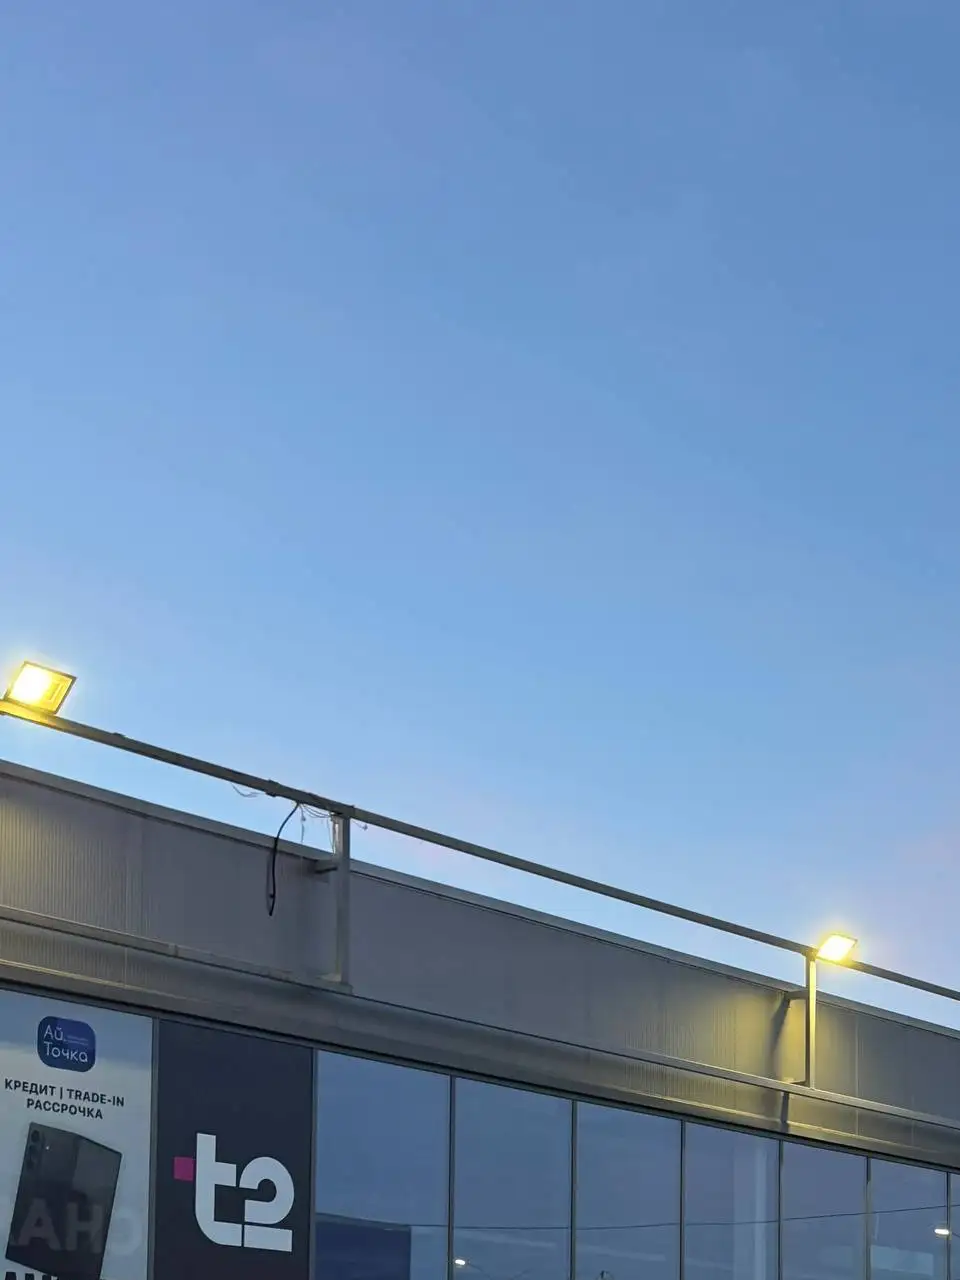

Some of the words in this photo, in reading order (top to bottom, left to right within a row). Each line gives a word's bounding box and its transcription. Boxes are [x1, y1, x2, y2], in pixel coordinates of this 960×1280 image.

[44, 1041, 88, 1064] Точка
[5, 1078, 56, 1097] КРЕДИТ
[67, 1088, 125, 1108] TRADE-IN
[26, 1098, 103, 1120] РАССРОЧКА
[195, 1132, 295, 1252] t2
